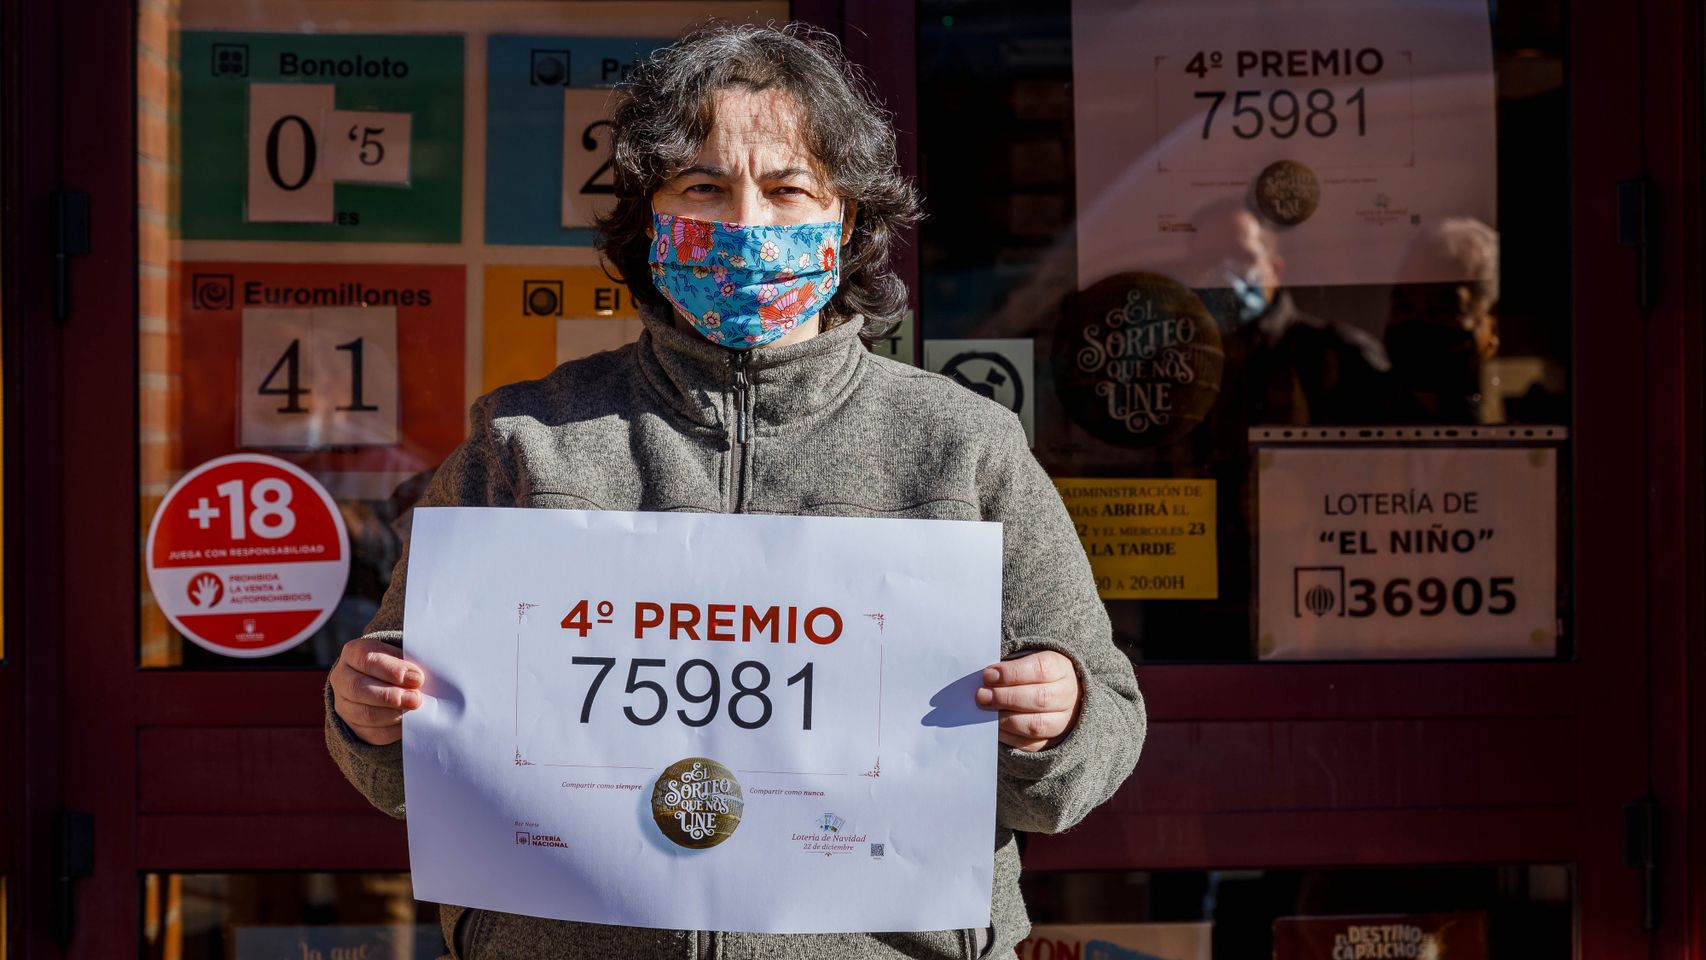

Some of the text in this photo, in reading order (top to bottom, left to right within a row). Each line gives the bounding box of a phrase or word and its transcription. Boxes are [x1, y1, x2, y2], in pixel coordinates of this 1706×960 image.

[280, 52, 409, 79] Bonoloto
[1185, 47, 1384, 78] 4º PREMIO
[1193, 86, 1366, 140] 75981
[265, 114, 317, 192] 0
[244, 281, 432, 307] Euromillones
[1077, 316, 1196, 373] SORTEO
[1106, 349, 1195, 385] QUE NOS
[1095, 380, 1173, 433] UNE
[1184, 485, 1203, 498] DE
[1323, 488, 1479, 515] LOTERÍA DE
[187, 477, 297, 541] +18
[1102, 500, 1169, 517] ABRIRÁ
[1173, 505, 1190, 516] EL
[1092, 527, 1100, 537] Y
[1103, 527, 1117, 537] EL
[1188, 522, 1206, 537] 23
[168, 544, 325, 561] JUEGA CON RESPONSABILIDAD
[1091, 541, 1177, 557] LA TARDE
[229, 573, 279, 583] PROHIBIDA
[1130, 575, 1185, 591] 20:00H
[230, 584, 284, 593] LA VENTA A
[230, 592, 313, 604] AUTOPROHIBIDOS
[1347, 576, 1517, 618] 36905
[559, 599, 844, 646] 4º PREMIO
[571, 655, 816, 731] 75981
[681, 762, 710, 783] EL
[561, 780, 596, 791] Compartir
[664, 777, 730, 806] SORTEO
[749, 786, 783, 796] Compartir
[784, 789, 803, 797] como
[681, 795, 730, 815] QUE NOS
[674, 811, 717, 840] UNE
[532, 833, 562, 842] LOTERÍA
[532, 840, 569, 848] NACIONAL
[791, 832, 867, 843] Lotería de Navidad
[821, 843, 854, 852] diciembre
[1348, 924, 1422, 944] DESTINO
